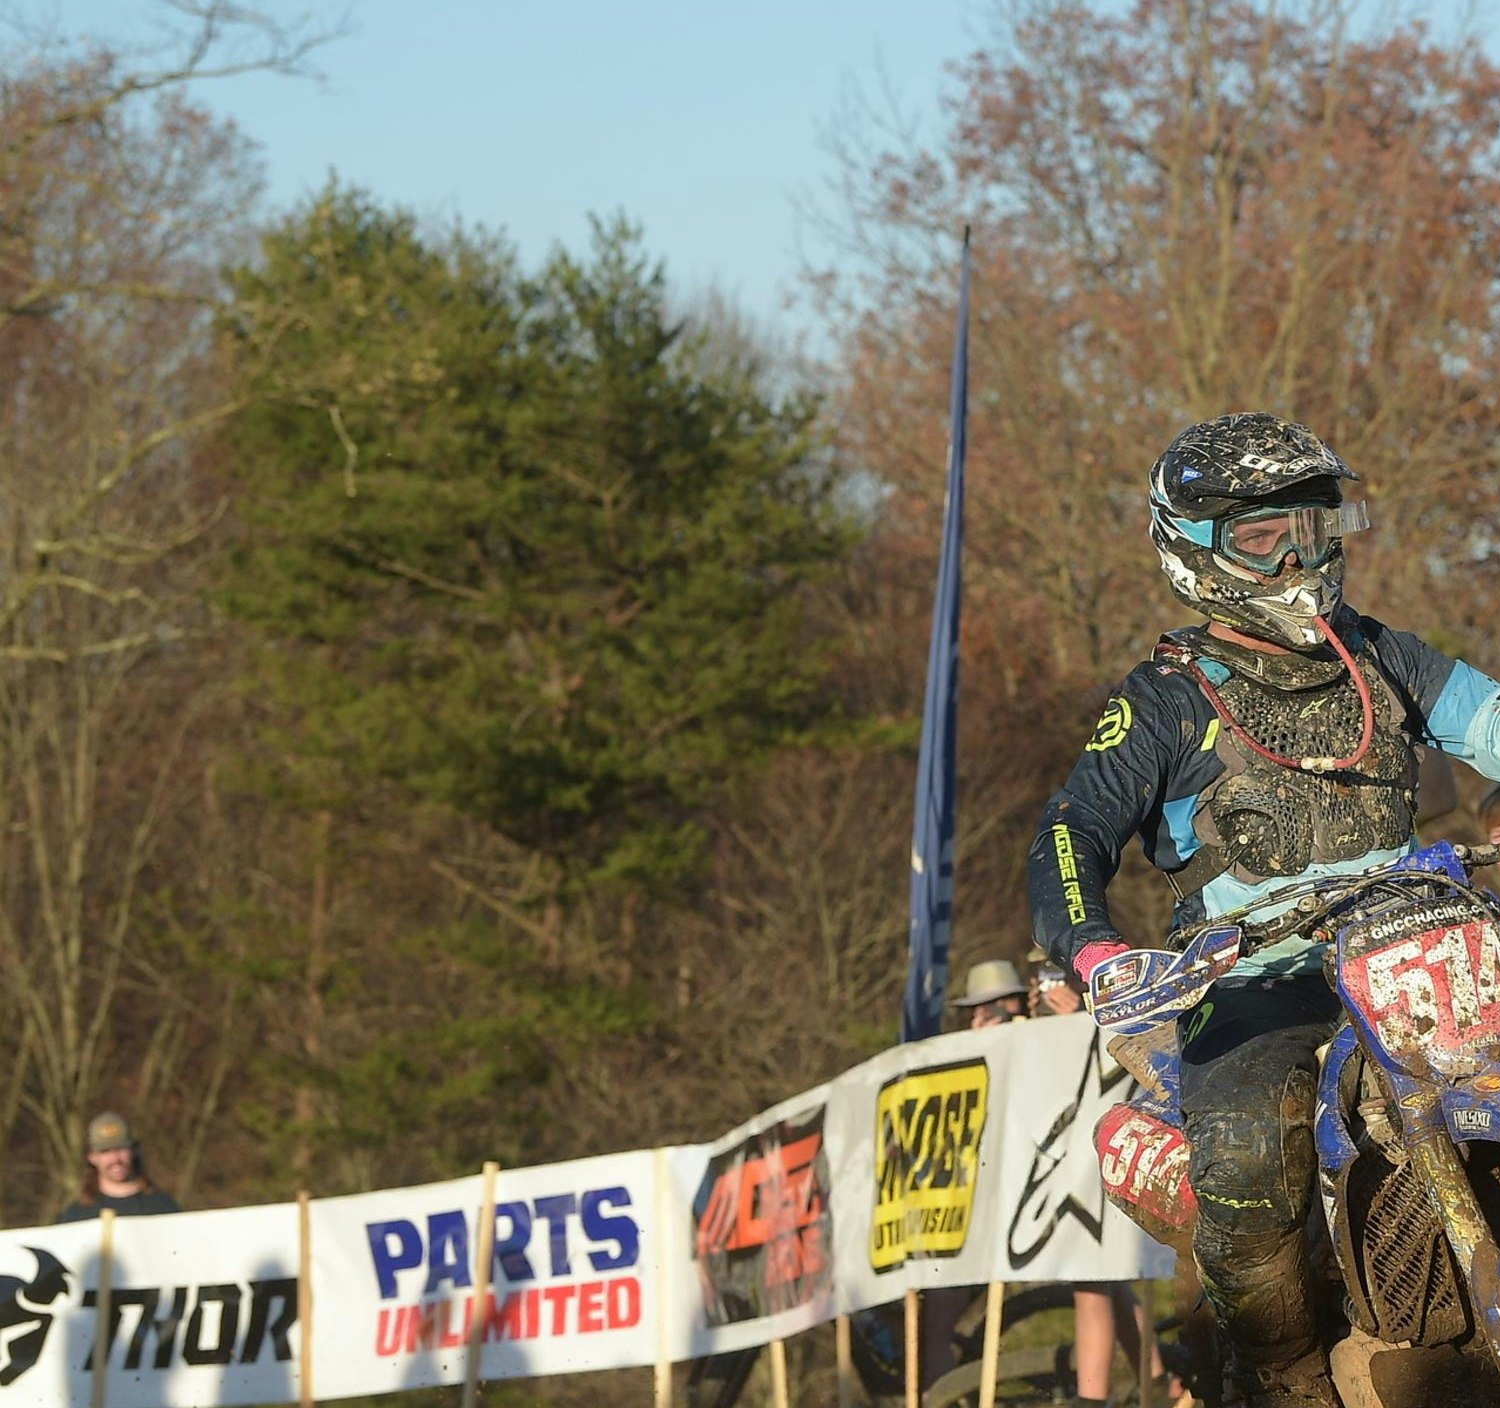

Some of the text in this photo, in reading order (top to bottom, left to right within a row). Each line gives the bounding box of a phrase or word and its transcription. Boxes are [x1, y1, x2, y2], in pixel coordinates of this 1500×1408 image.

[366, 1186, 640, 1300] PARTS
[81, 1277, 299, 1371] THOR
[375, 1276, 642, 1358] UNLIMITED
